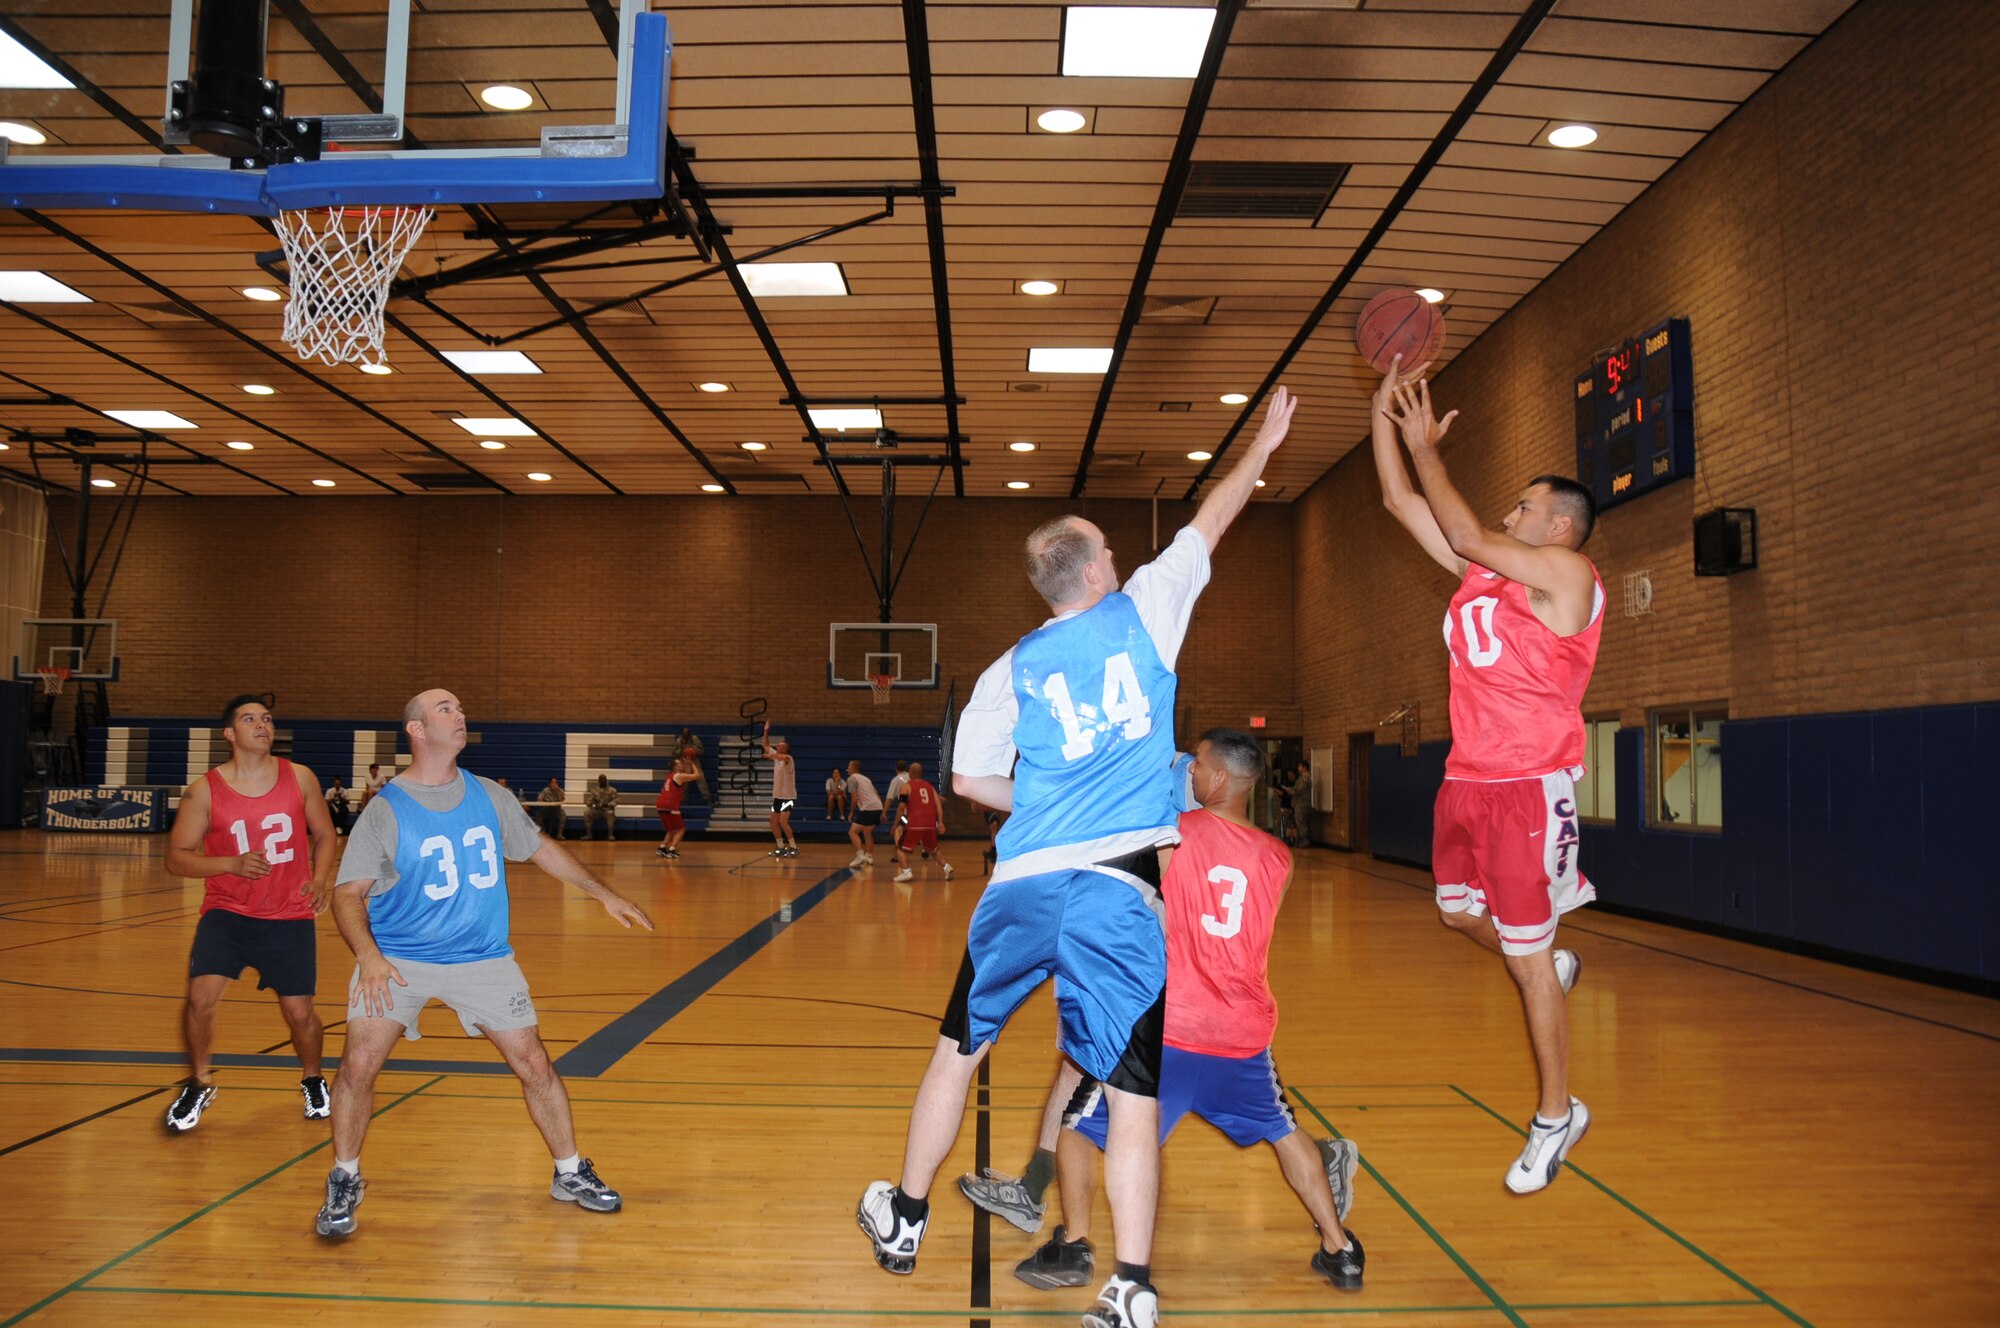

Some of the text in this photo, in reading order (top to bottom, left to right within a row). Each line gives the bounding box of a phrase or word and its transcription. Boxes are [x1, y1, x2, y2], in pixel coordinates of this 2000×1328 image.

[1042, 651, 1152, 762] 14
[46, 807, 151, 829] THUNDERBOLTS
[47, 789, 152, 806] HOME OF THE
[919, 787, 929, 804] 9
[230, 812, 294, 865] 12
[420, 825, 499, 901] 33
[1554, 798, 1578, 878] CATS
[1201, 864, 1248, 939] 3
